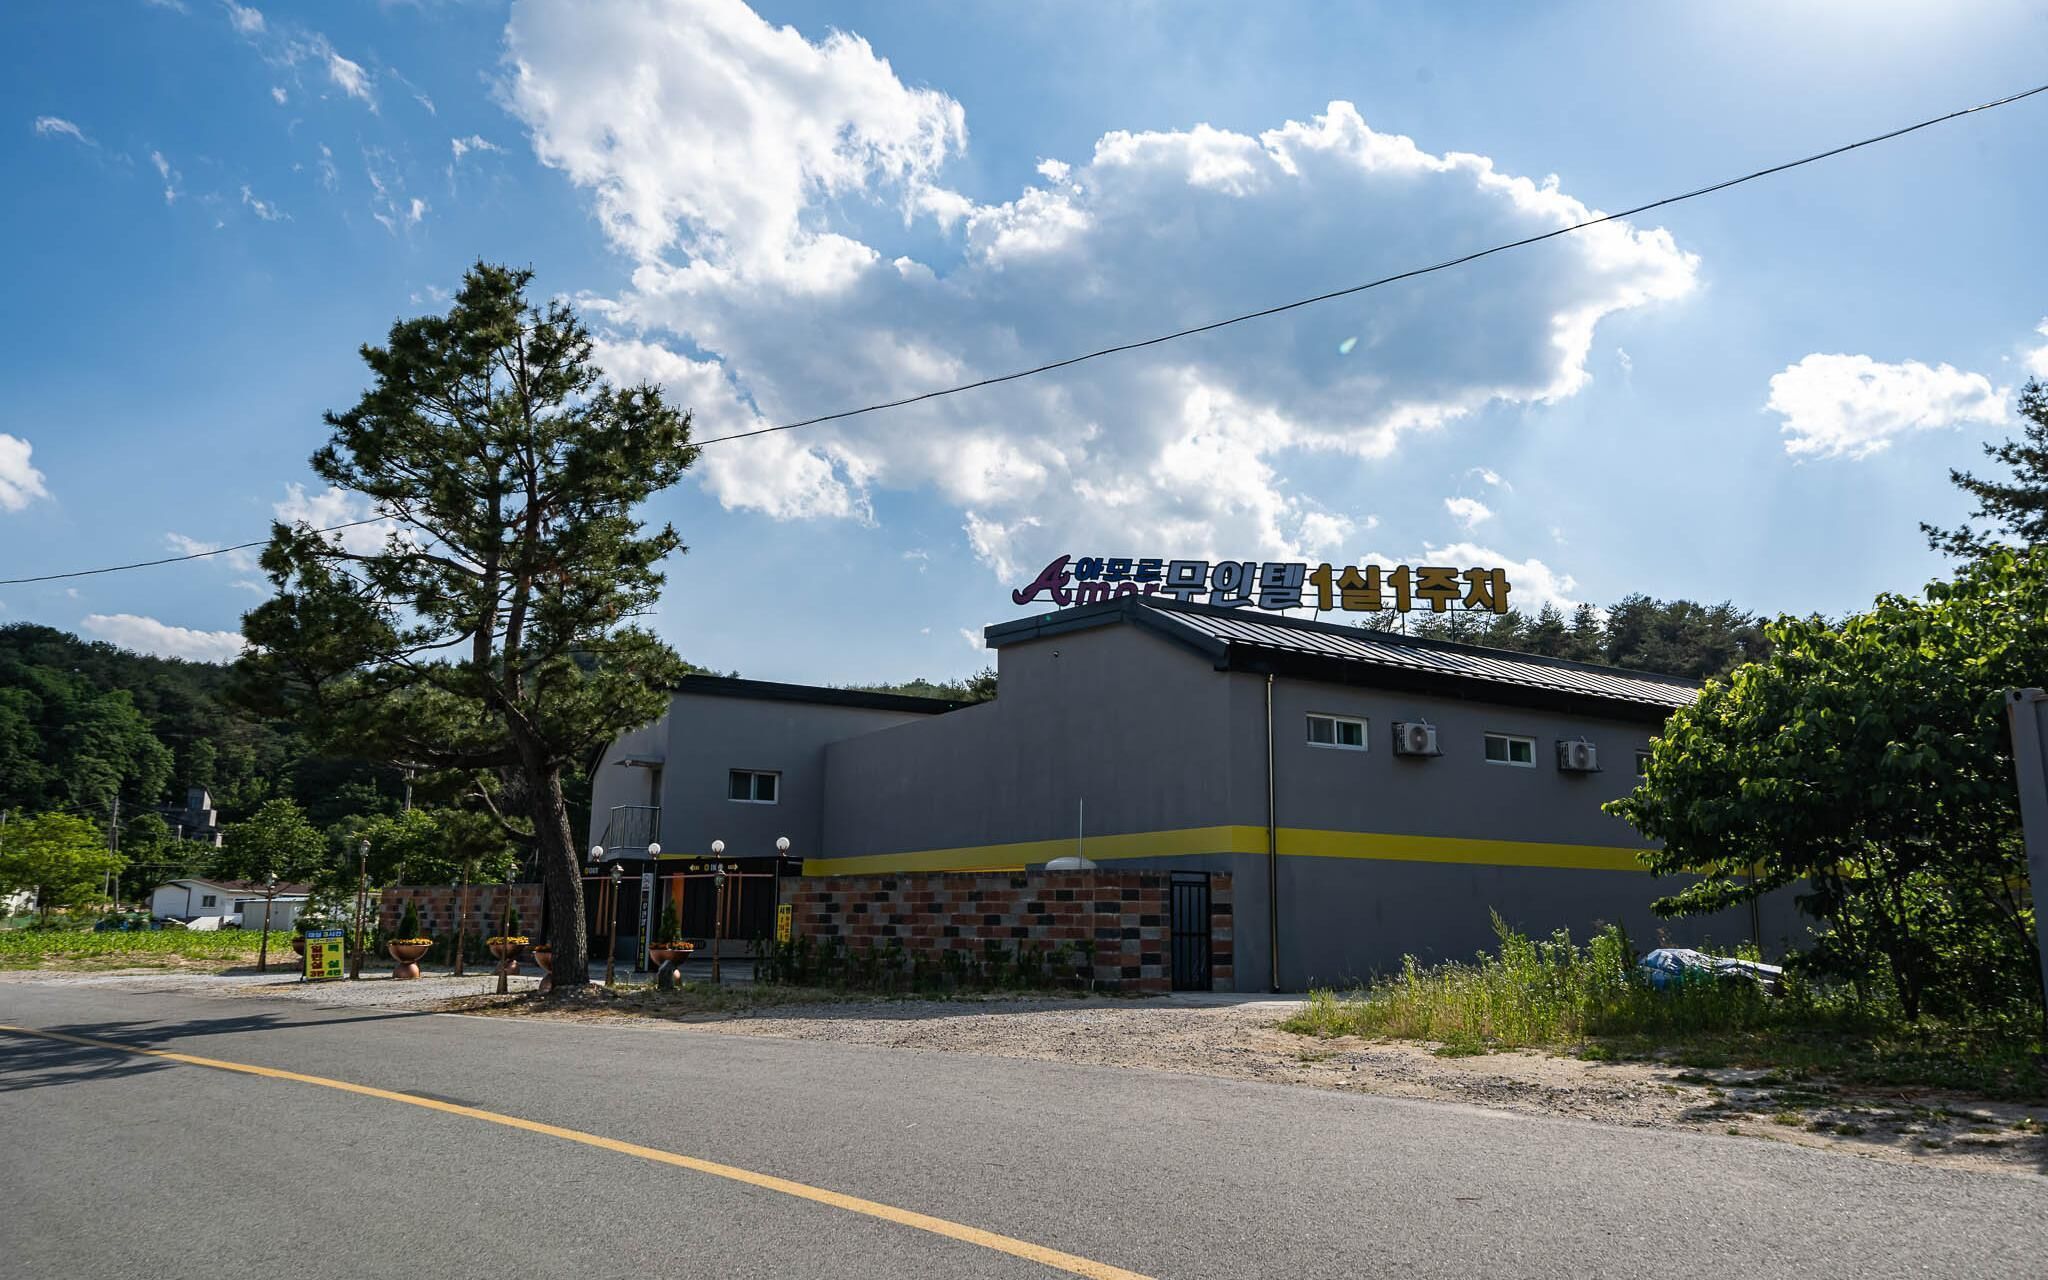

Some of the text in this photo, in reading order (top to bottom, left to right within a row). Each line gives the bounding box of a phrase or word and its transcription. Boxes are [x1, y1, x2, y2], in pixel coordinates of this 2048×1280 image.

[1011, 554, 1160, 607] Amor
[1074, 557, 1164, 582] 아모르
[1160, 560, 1307, 610] 무인텔
